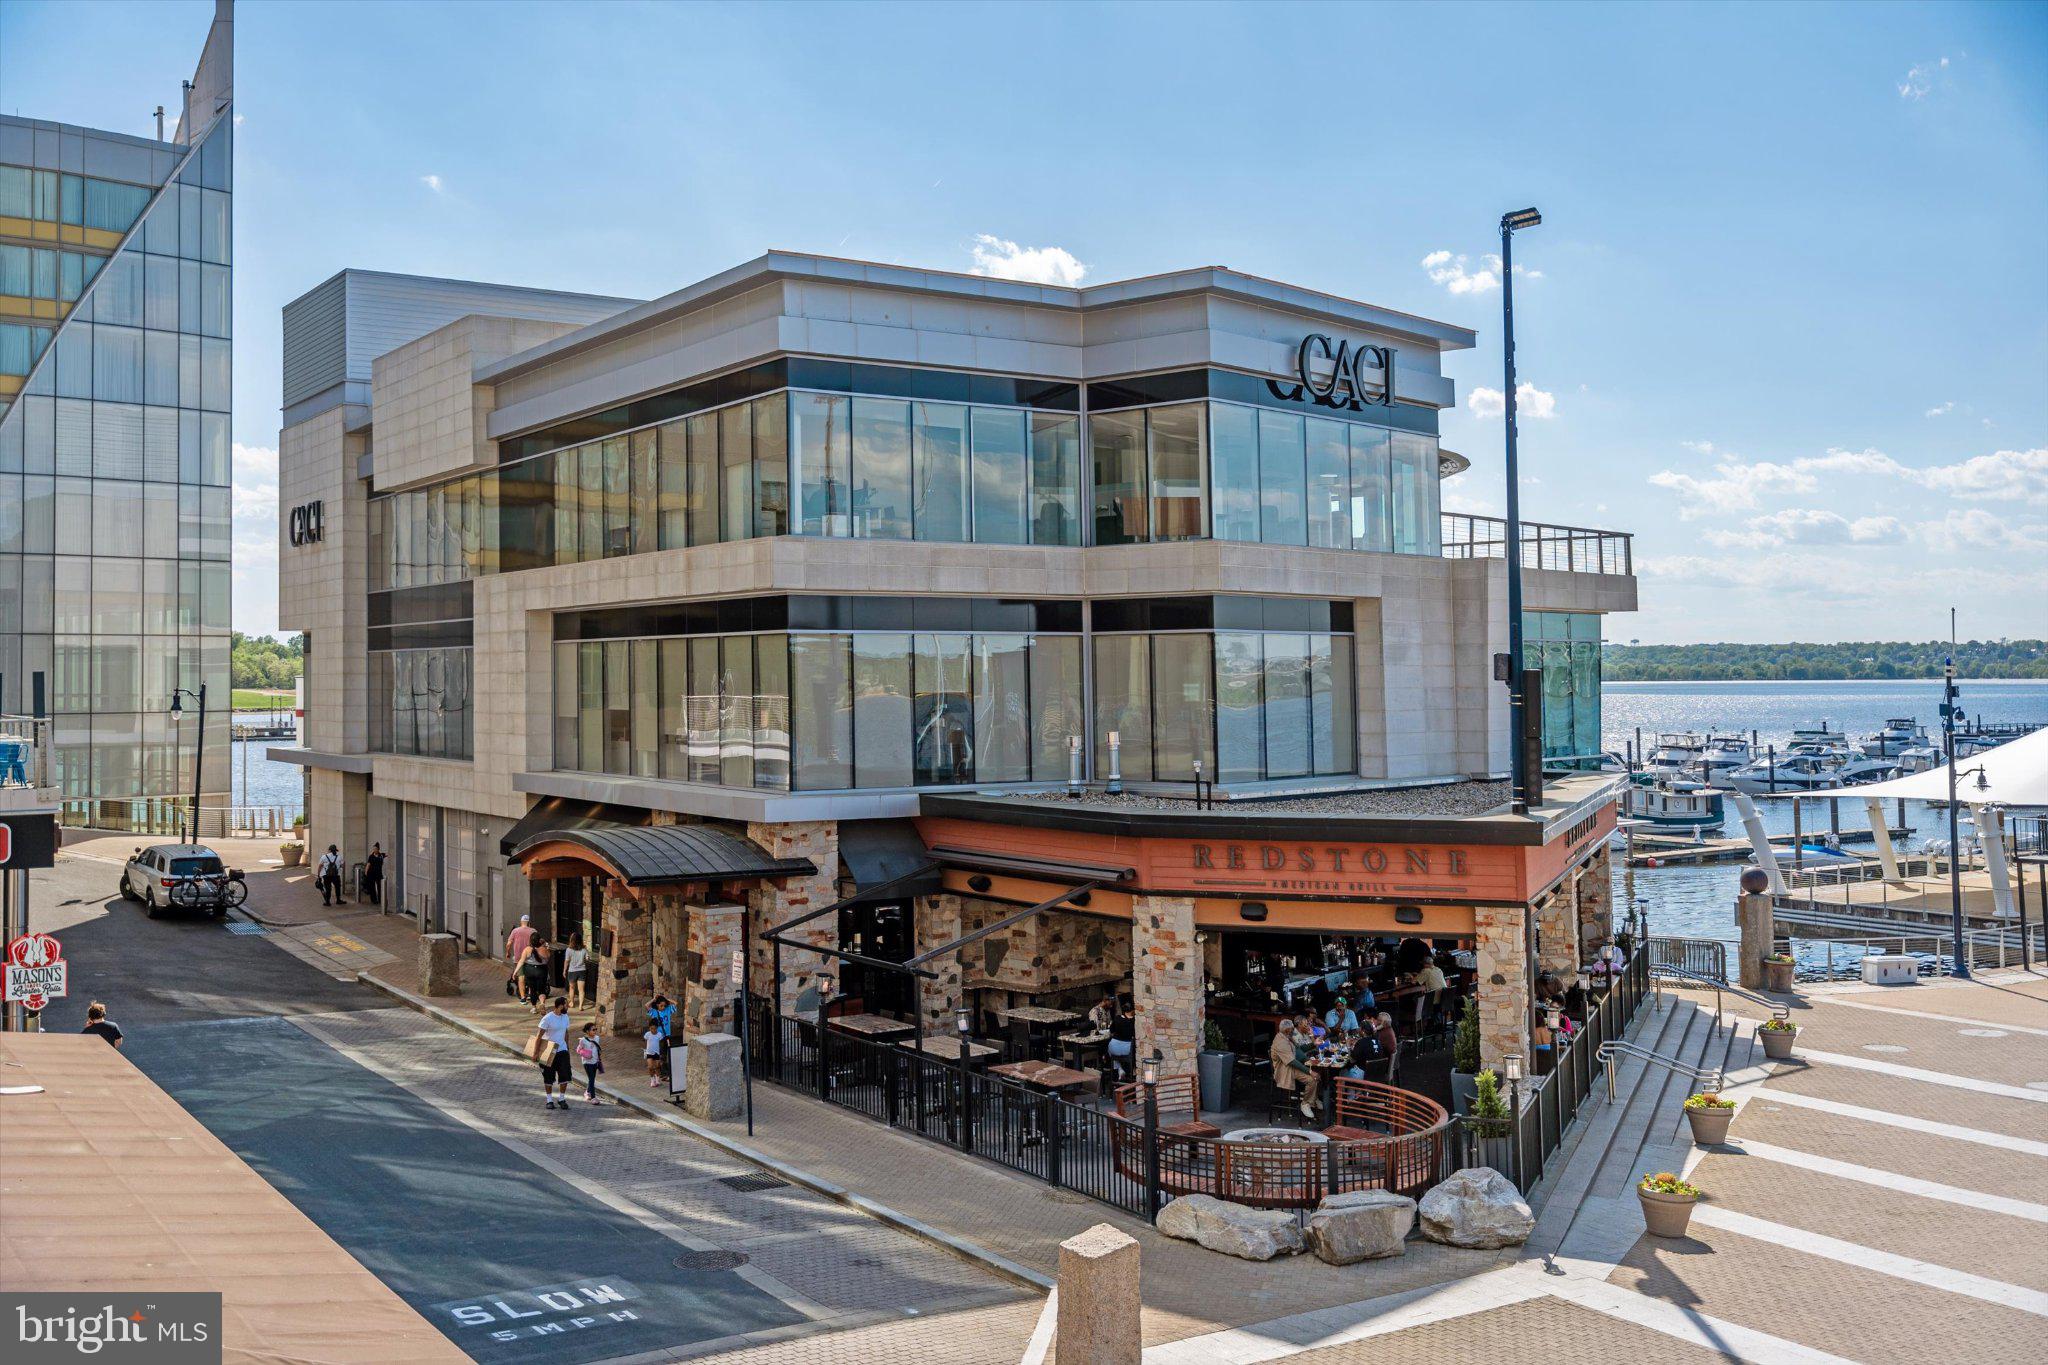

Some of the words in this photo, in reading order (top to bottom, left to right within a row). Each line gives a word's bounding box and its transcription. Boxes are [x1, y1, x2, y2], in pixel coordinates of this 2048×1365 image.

[1299, 333, 1399, 408] CACI
[289, 500, 324, 547] CACI
[1191, 844, 1469, 876] REDSTONE
[451, 1284, 626, 1326] SLOW
[491, 1330, 518, 1342] 5
[532, 1310, 639, 1336] MPH
